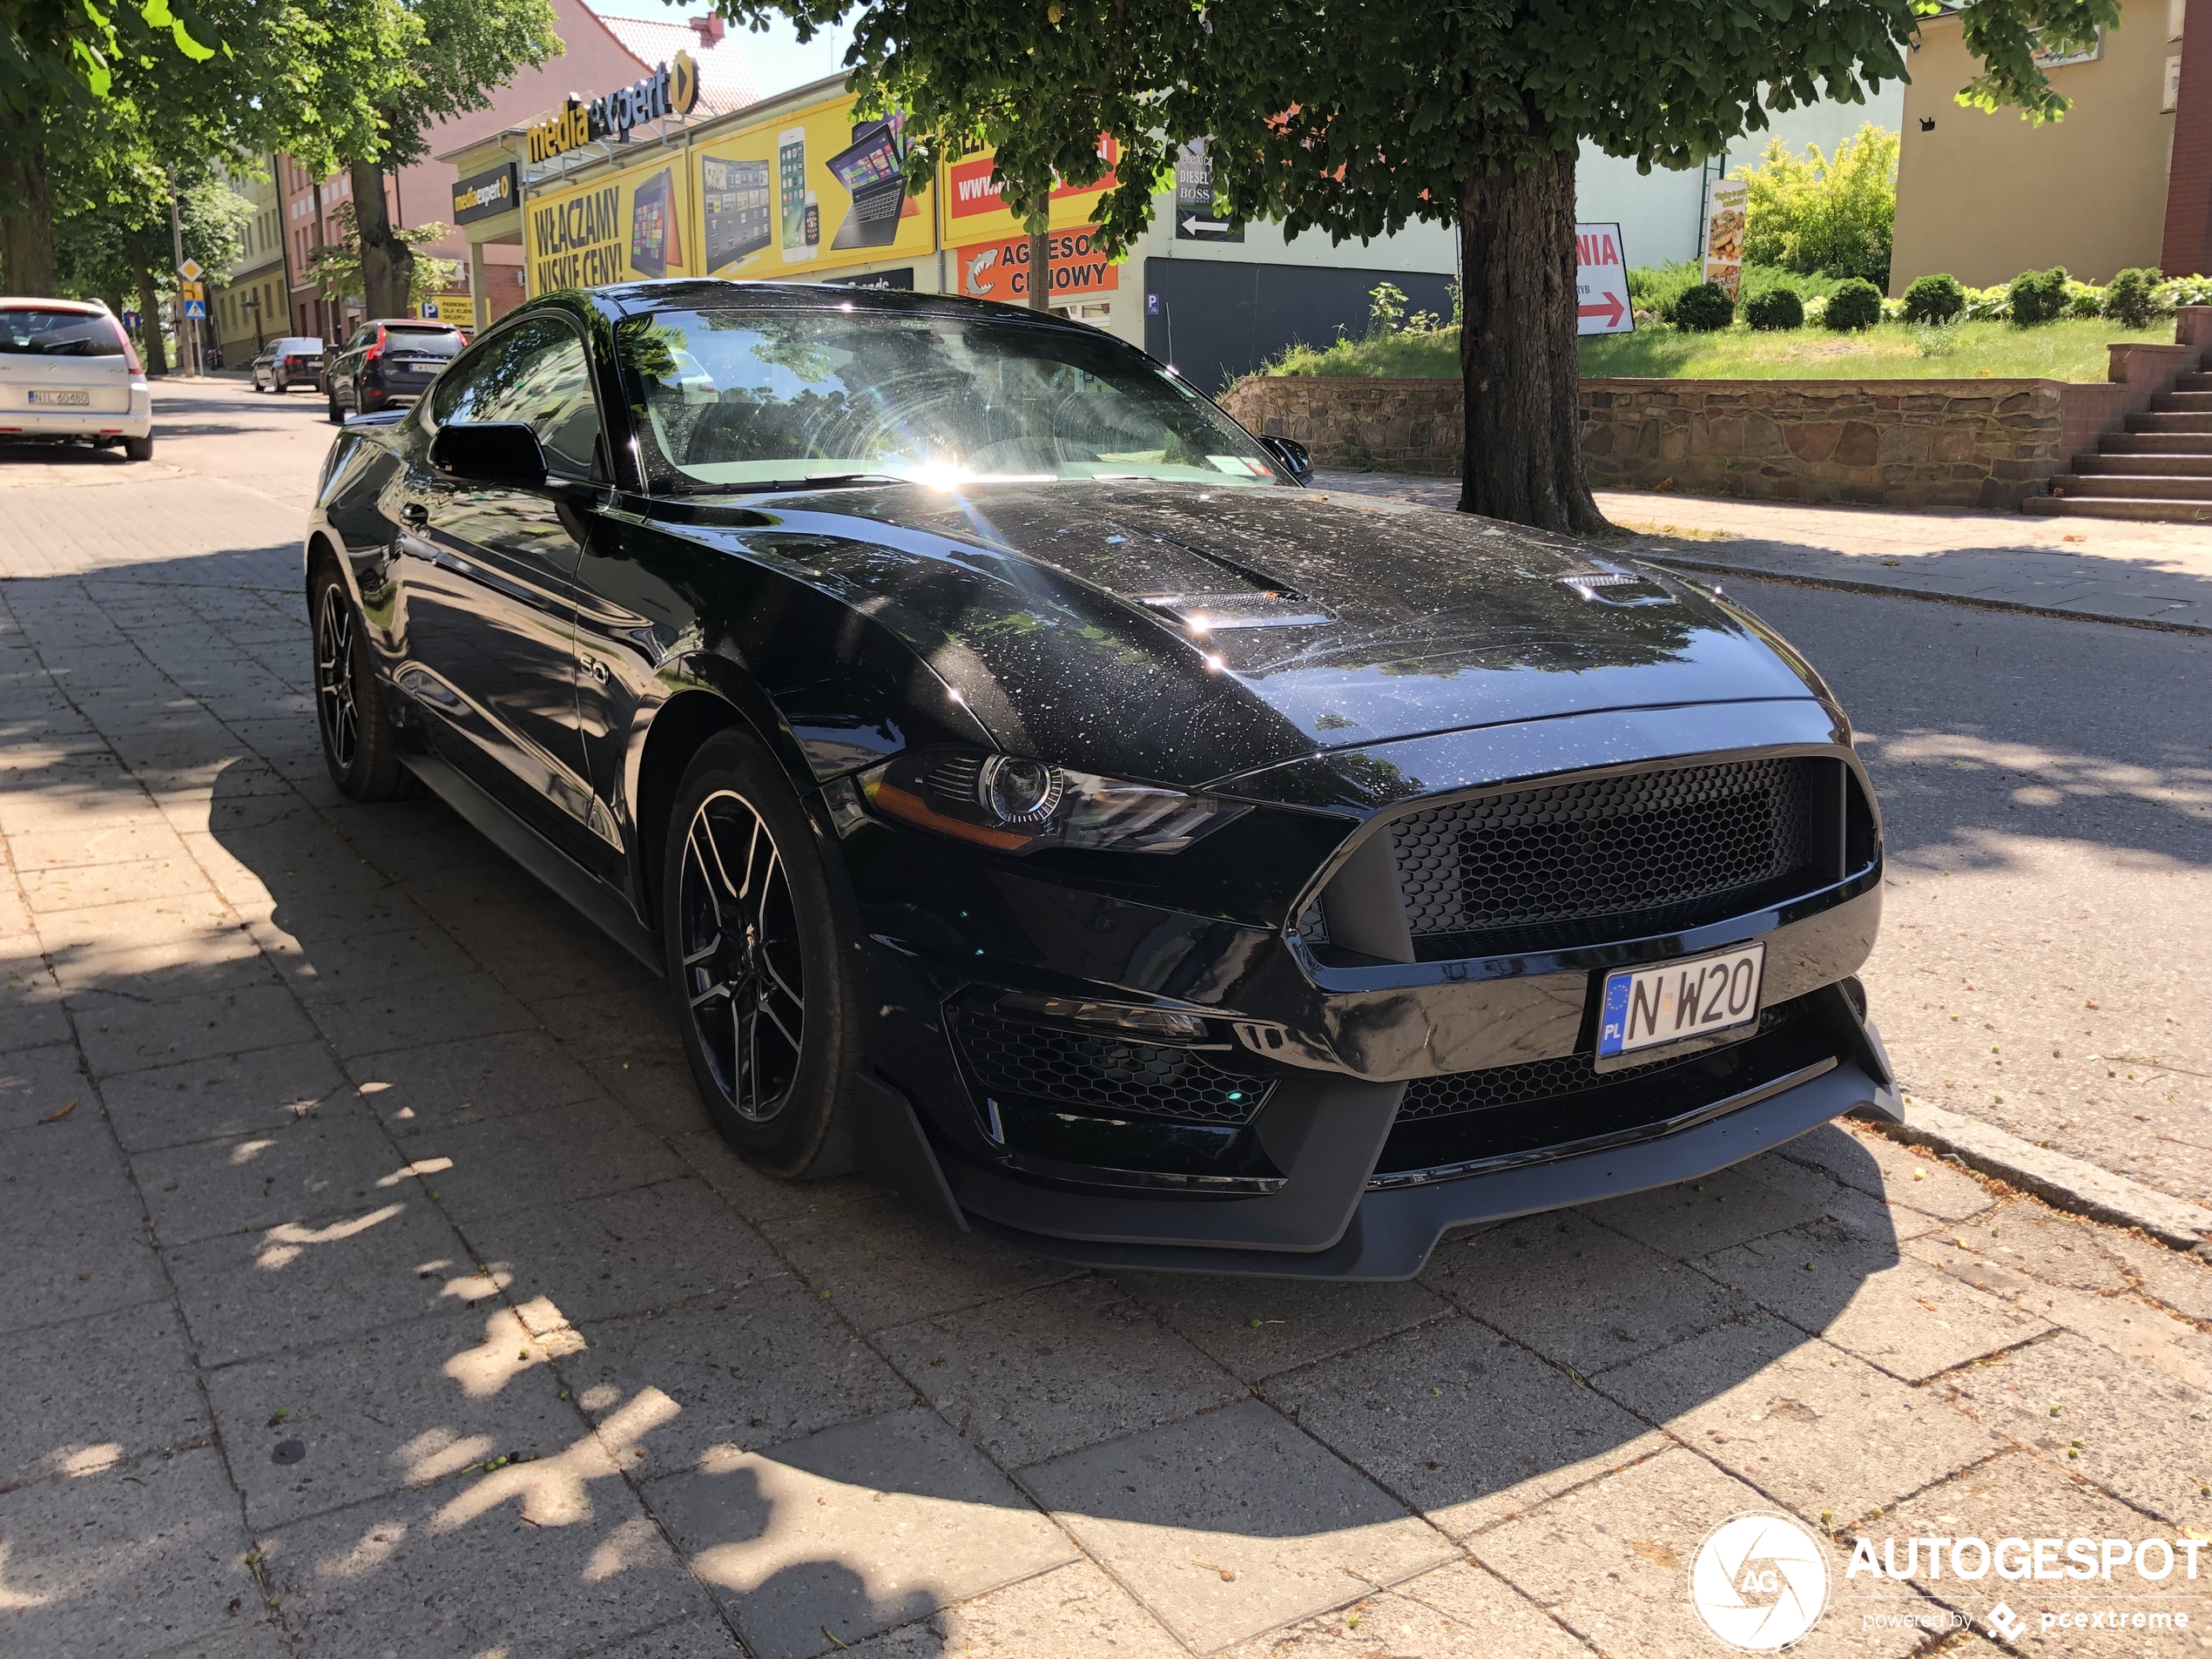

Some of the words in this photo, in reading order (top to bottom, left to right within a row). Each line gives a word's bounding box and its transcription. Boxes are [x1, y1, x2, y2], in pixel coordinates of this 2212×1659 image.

[1180, 170, 1210, 185] DIESEL
[1180, 187, 1210, 200] BOSS
[534, 185, 620, 257] WŁĄCZAMY
[583, 242, 623, 287] CENY!
[1001, 234, 1108, 266] AGESO
[1575, 234, 1619, 266] NIA
[1603, 1022, 1622, 1042] PL
